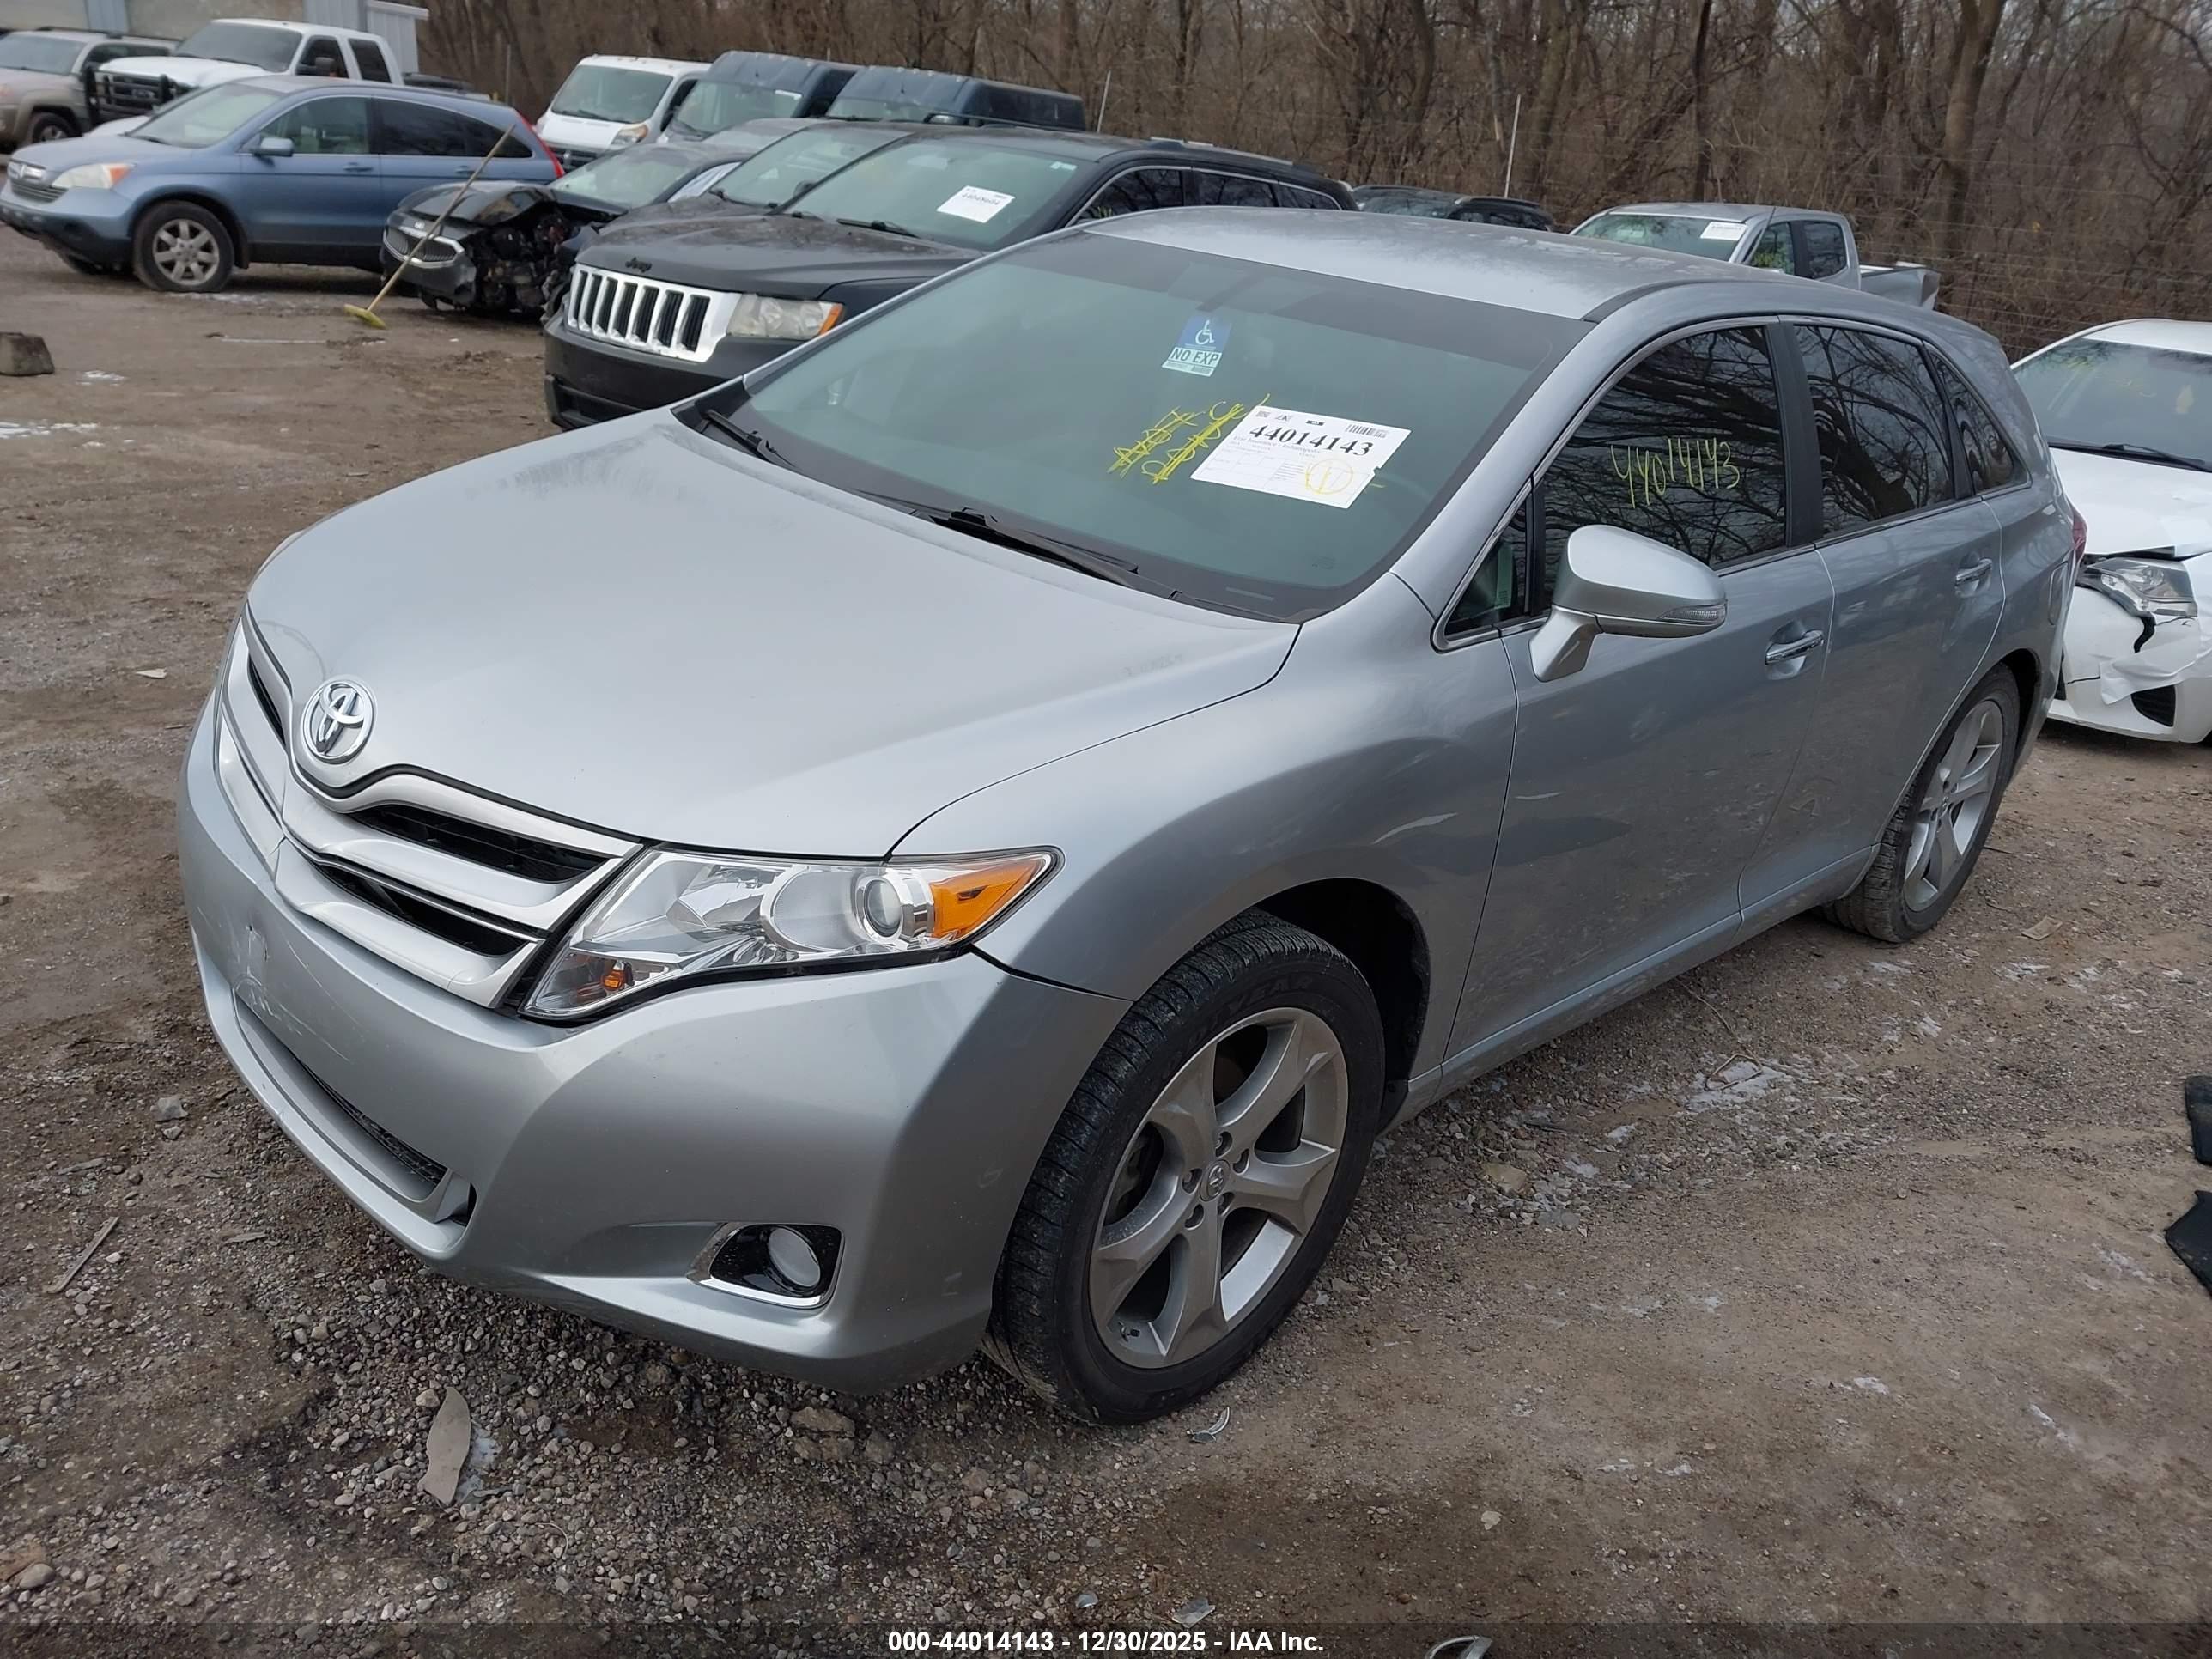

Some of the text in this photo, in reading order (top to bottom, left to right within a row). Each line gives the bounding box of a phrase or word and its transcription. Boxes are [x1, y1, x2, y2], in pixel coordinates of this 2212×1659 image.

[1170, 348, 1219, 366] NO EXP
[1249, 424, 1374, 456] 44014143
